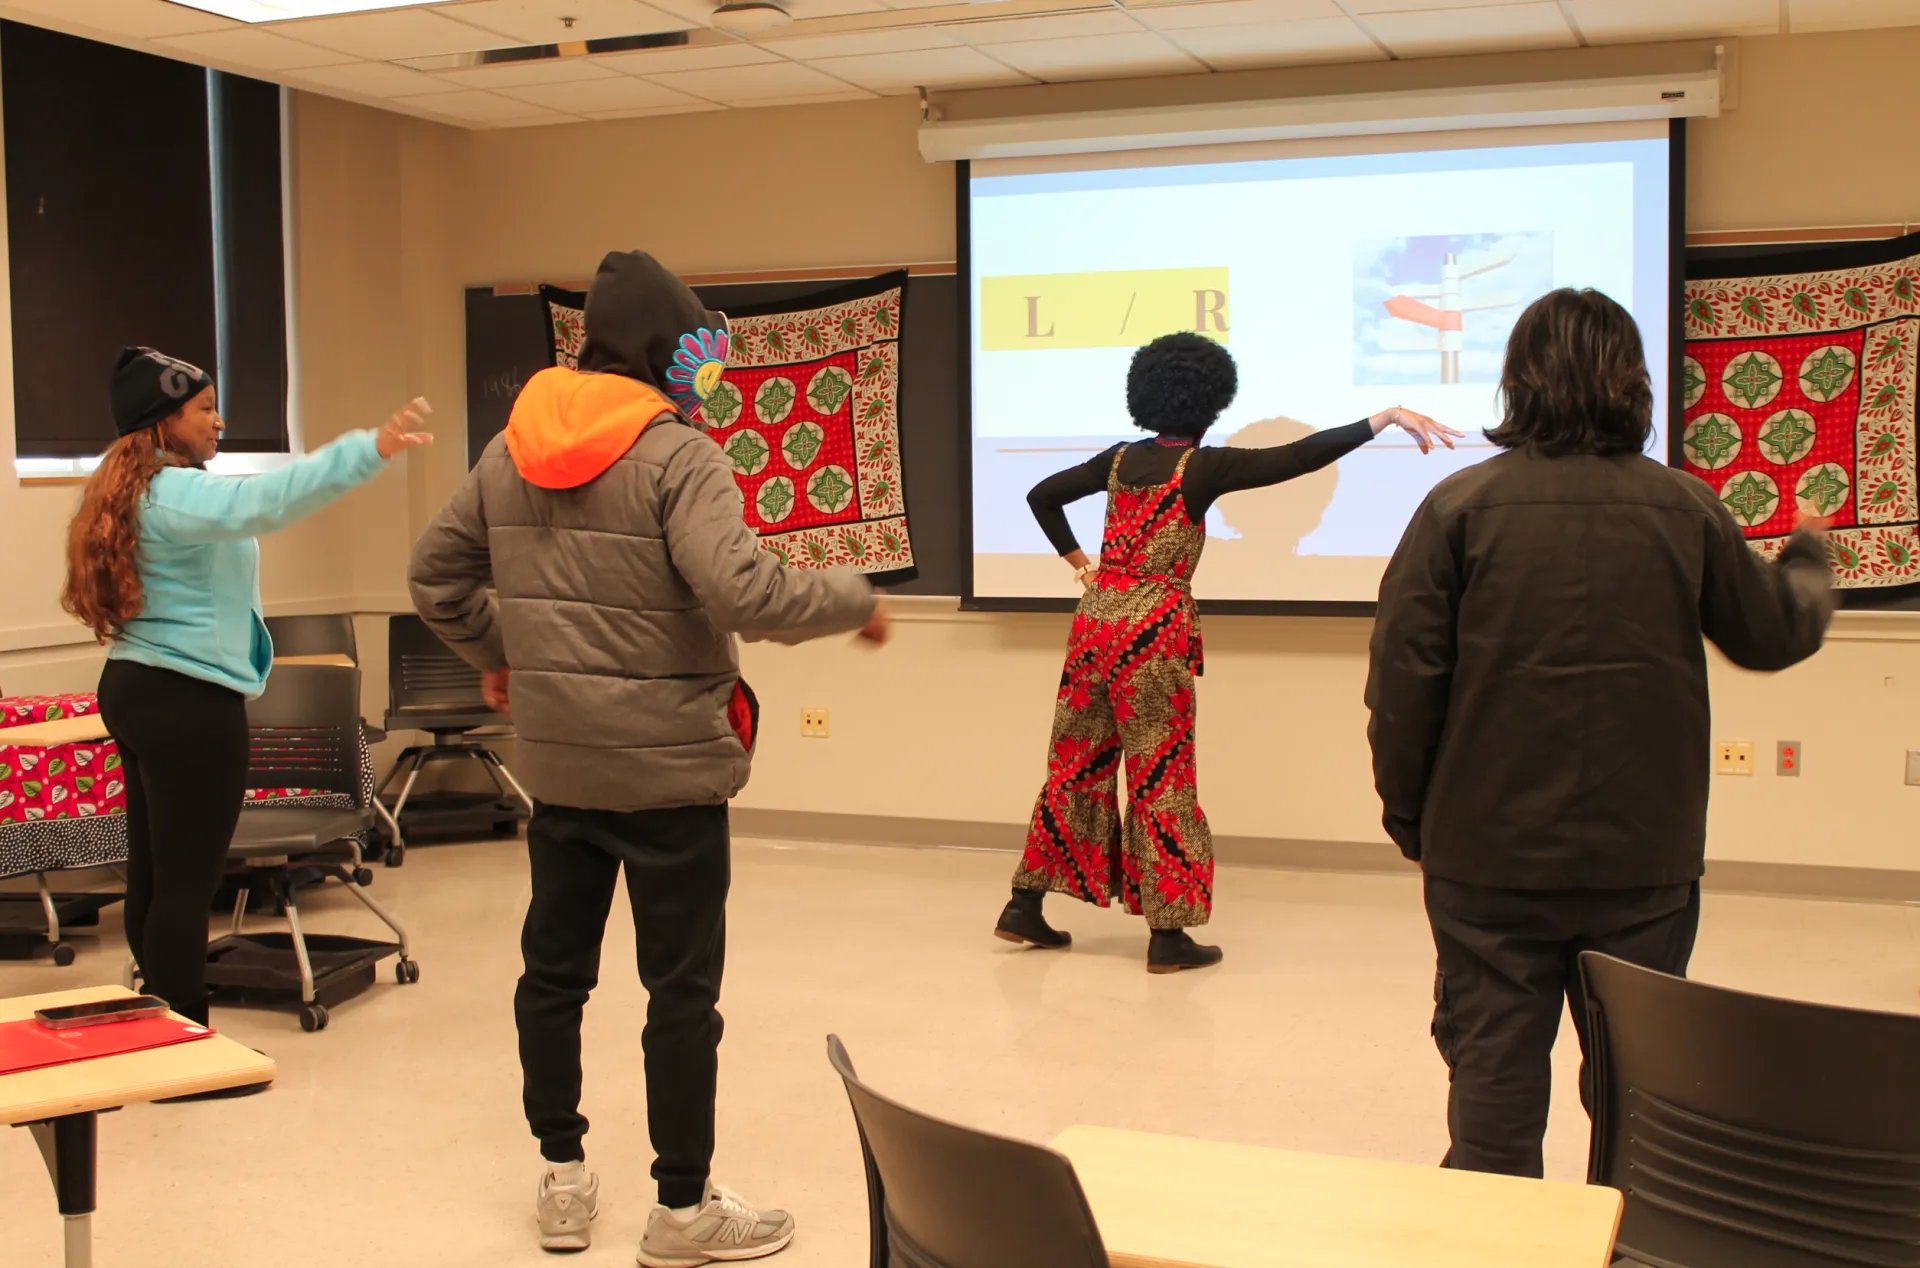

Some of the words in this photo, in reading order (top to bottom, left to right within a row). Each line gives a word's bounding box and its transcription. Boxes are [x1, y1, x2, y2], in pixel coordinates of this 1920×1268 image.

[1023, 295, 1055, 338] L
[1192, 288, 1231, 332] R
[718, 1218, 752, 1246] N
